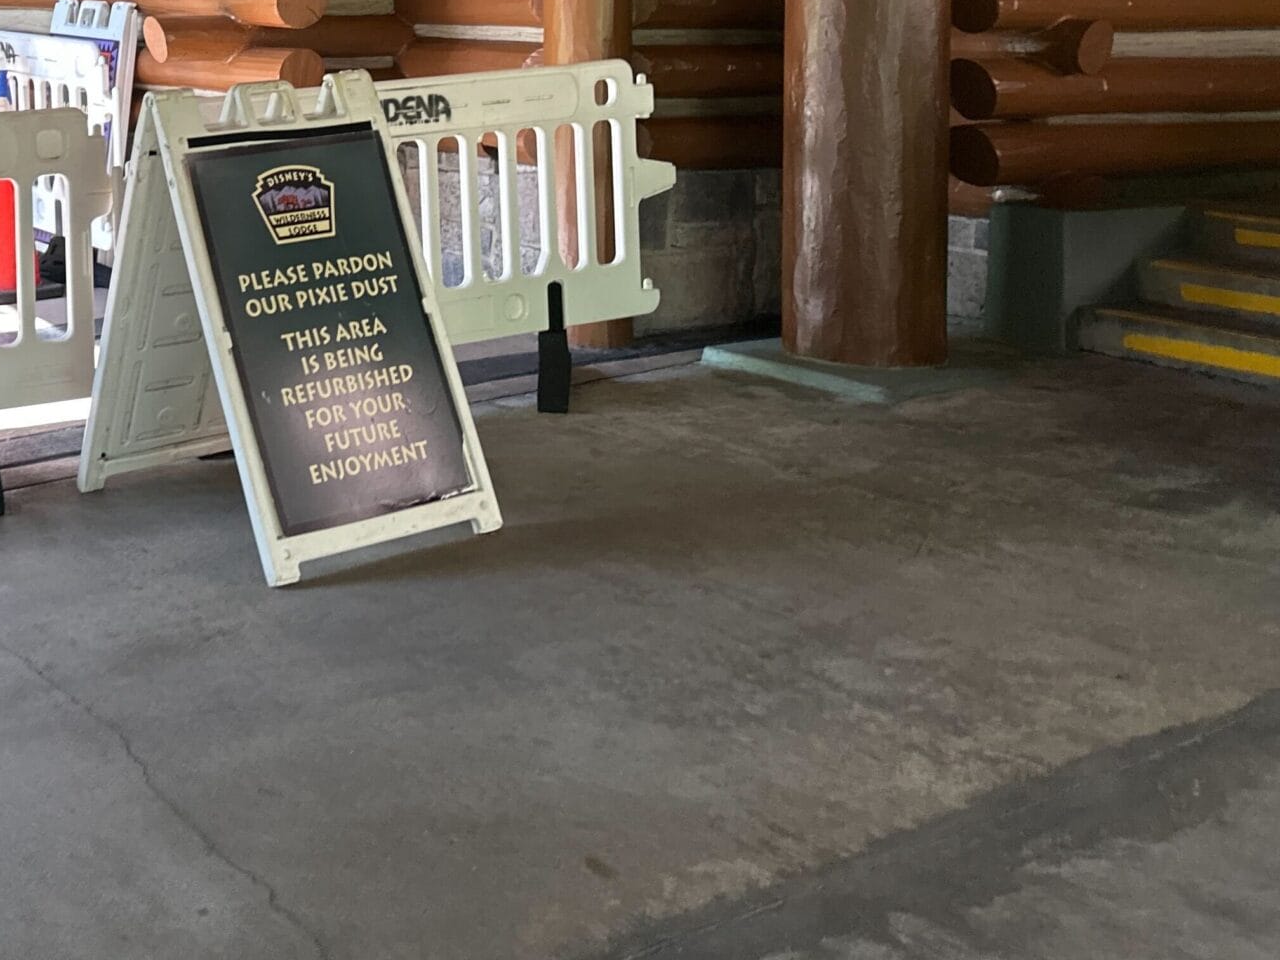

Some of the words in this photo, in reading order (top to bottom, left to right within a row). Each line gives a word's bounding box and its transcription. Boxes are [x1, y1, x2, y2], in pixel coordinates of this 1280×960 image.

[380, 94, 452, 122] DENA
[266, 171, 313, 187] DISNEY'S
[273, 210, 327, 224] WILDERNESS
[288, 223, 318, 236] LODGE
[238, 264, 309, 293] PLEASE
[312, 251, 393, 279] PARDON
[245, 294, 293, 317] OUR
[296, 283, 348, 309] PIXIE
[351, 275, 398, 299] DUST
[280, 326, 331, 351] THIS
[336, 317, 387, 342] AREA
[301, 354, 320, 376] IS
[324, 343, 384, 371] BEING
[281, 364, 413, 407] REFURBISHED
[305, 405, 347, 429] FOR
[349, 392, 406, 419] YOUR
[324, 420, 401, 453] FUTURE
[309, 440, 427, 484] ENJOYMENT
